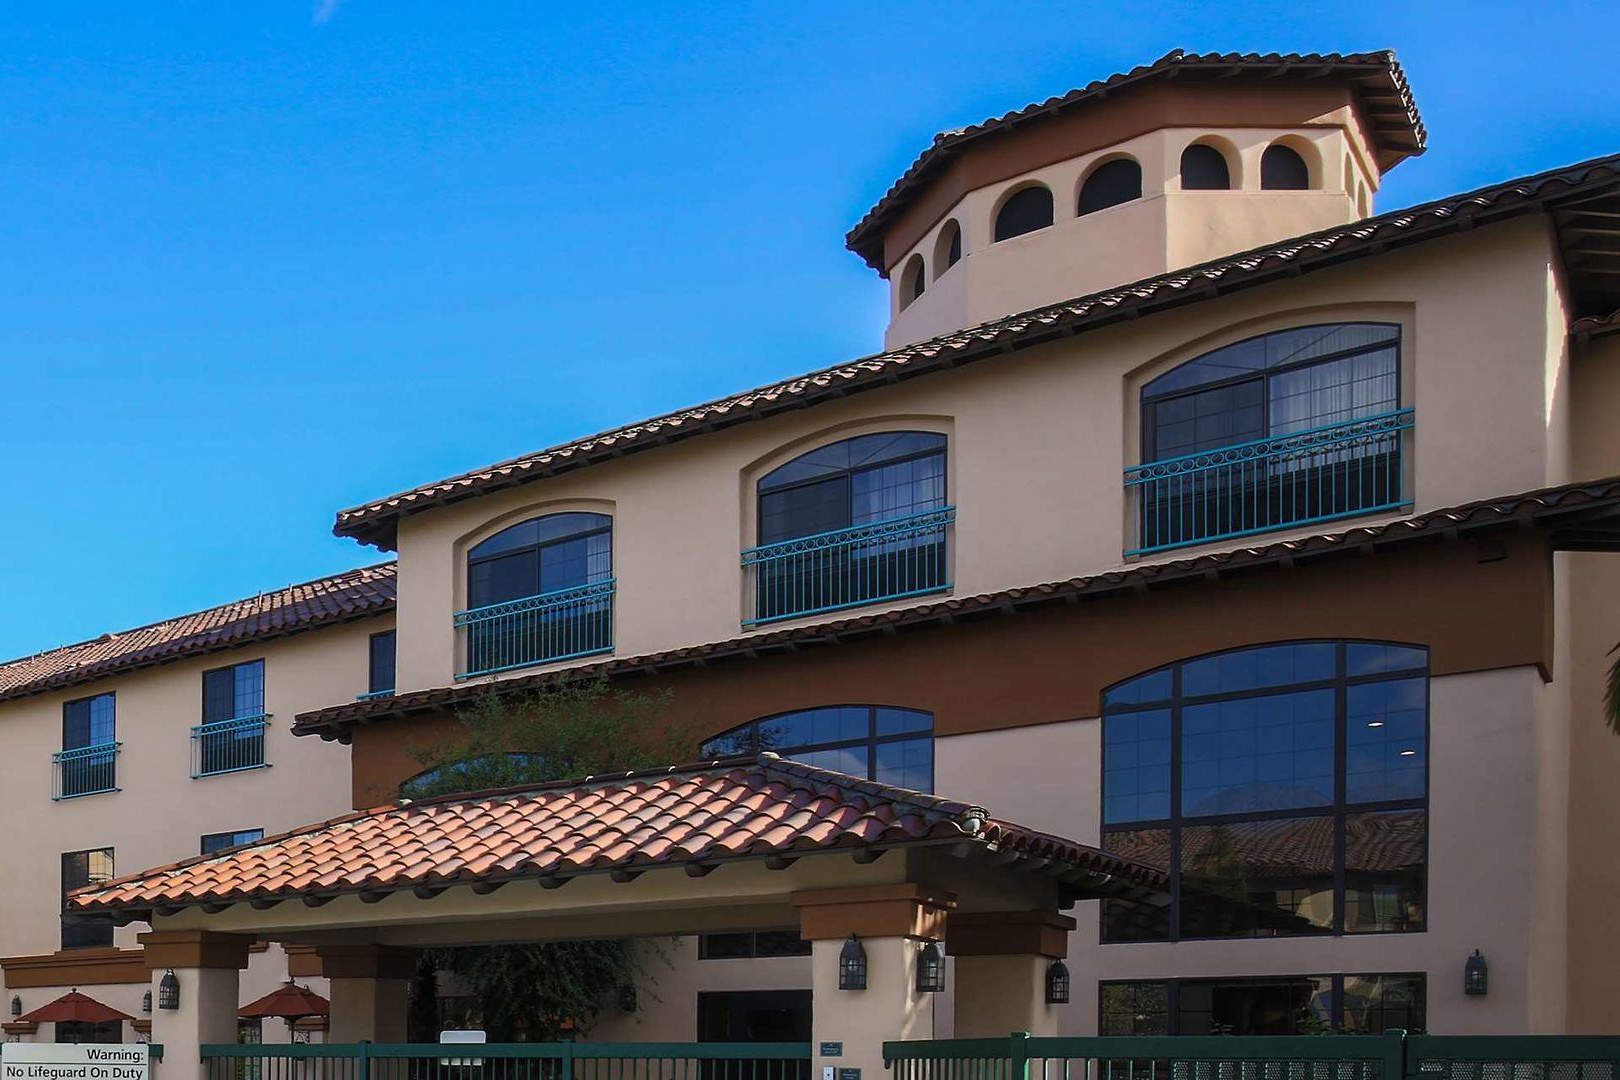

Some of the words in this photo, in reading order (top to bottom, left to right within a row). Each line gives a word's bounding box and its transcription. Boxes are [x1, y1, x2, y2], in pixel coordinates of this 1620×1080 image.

[87, 1049, 144, 1063] Warning:
[6, 1066, 24, 1078] No
[28, 1066, 86, 1080] Lifeguard
[90, 1067, 109, 1078] On
[113, 1067, 143, 1080] Duty
